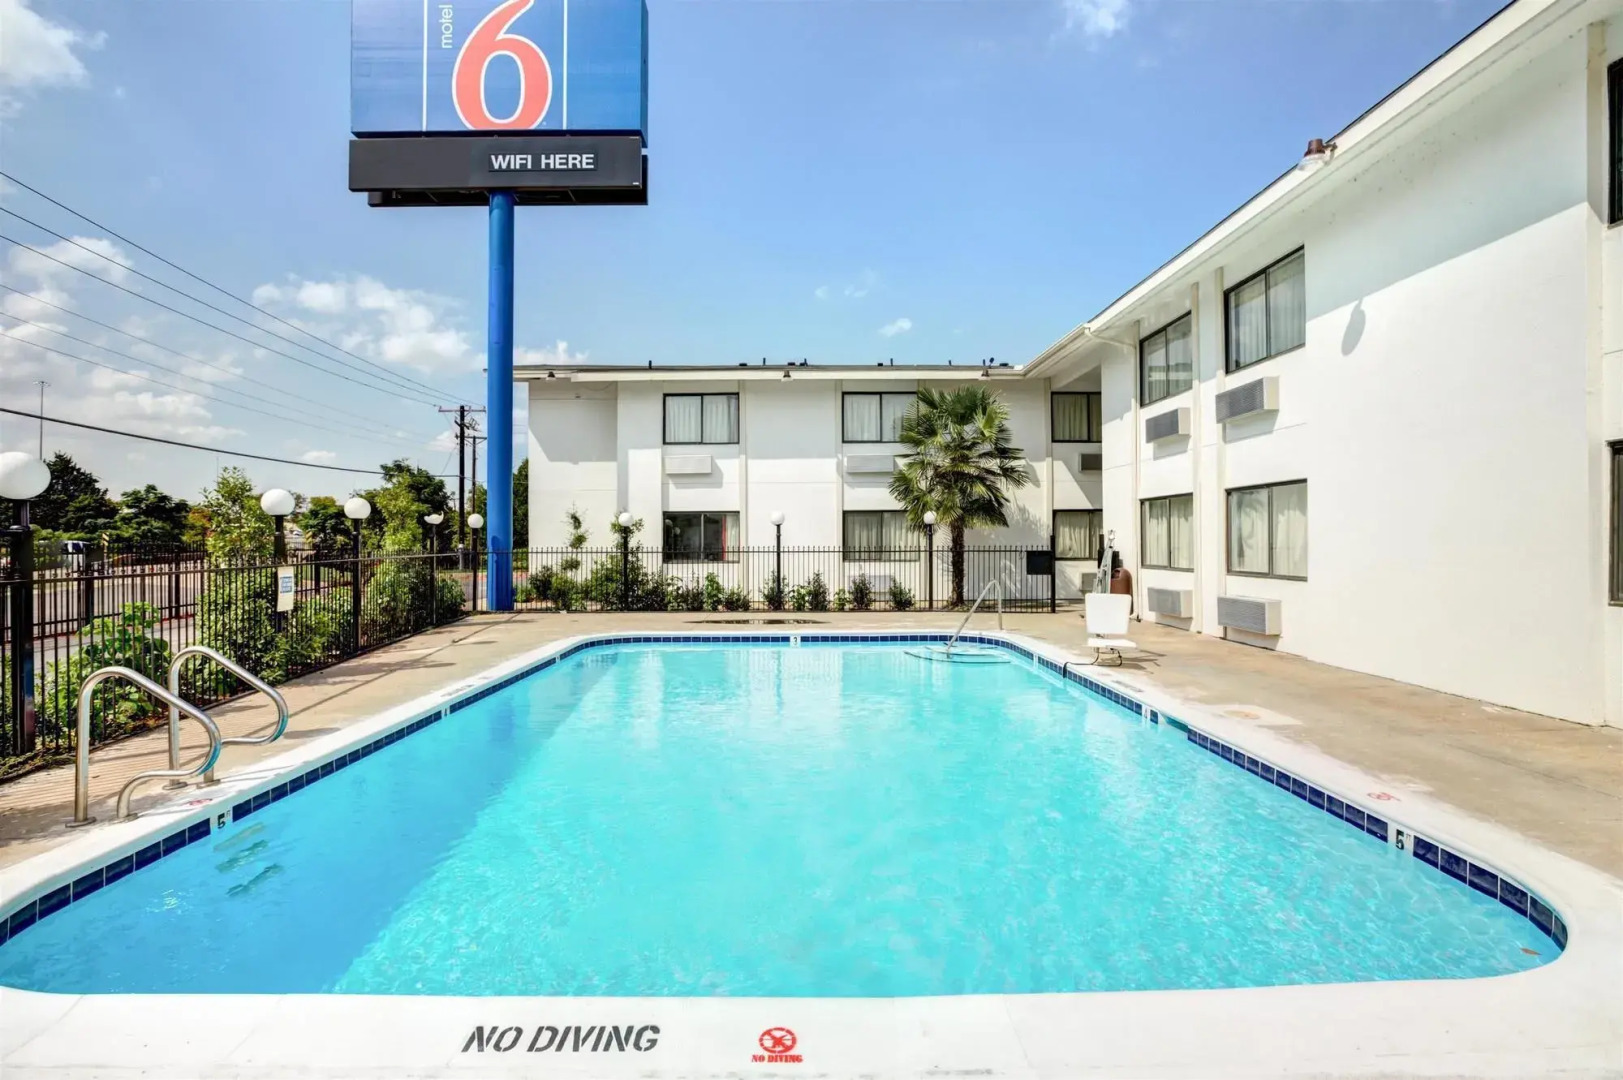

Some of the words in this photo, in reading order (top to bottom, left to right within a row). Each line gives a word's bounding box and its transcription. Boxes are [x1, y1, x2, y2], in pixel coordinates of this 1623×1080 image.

[438, 4, 453, 49] motel
[452, 0, 553, 130] 6
[490, 154, 532, 170] WIFI
[541, 154, 595, 169] HERE
[460, 1026, 524, 1053] NO
[526, 1025, 661, 1053] DIVING
[751, 1054, 766, 1063] NO
[767, 1054, 803, 1063] DIVING
